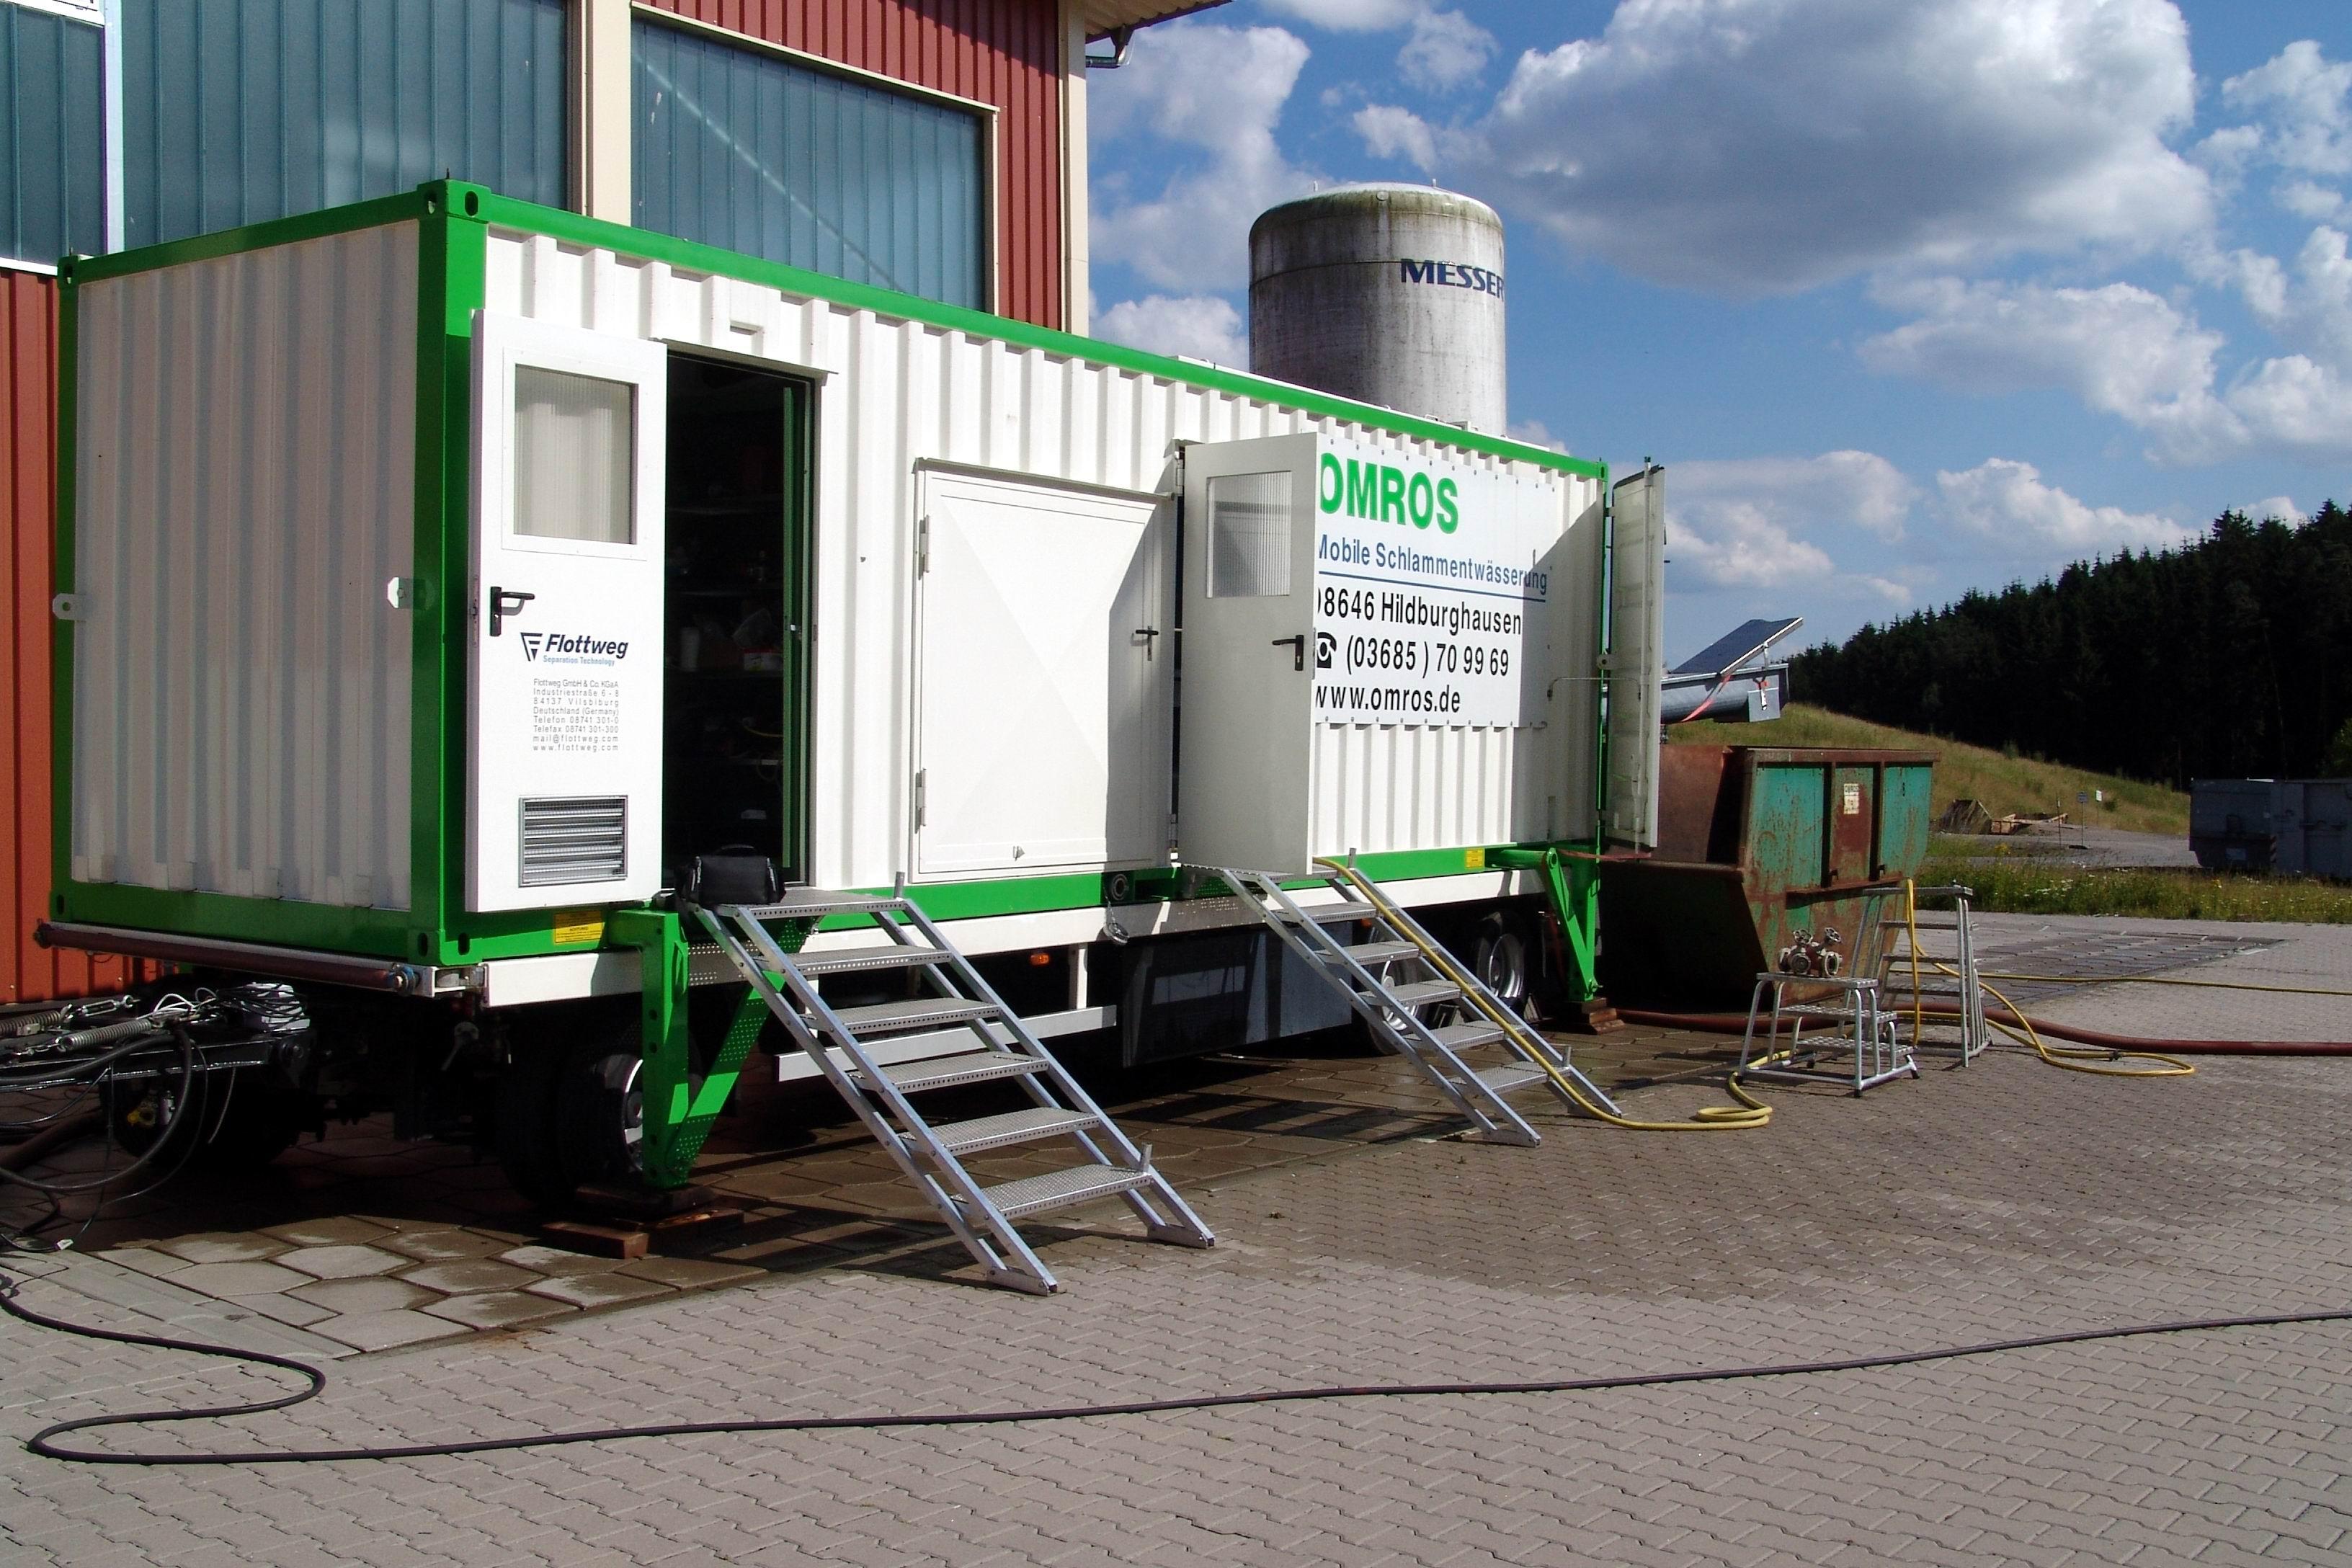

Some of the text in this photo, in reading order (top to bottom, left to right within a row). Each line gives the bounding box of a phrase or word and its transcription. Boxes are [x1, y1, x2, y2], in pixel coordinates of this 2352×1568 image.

[1401, 258, 1504, 302] MESSER
[1320, 453, 1459, 534] OMROS
[1376, 542, 1548, 595] Schlammentwässerung
[1318, 587, 1521, 636] 8646 Hildburghausen
[545, 633, 629, 659] Flottweg
[543, 655, 615, 667] Separation Technology
[1436, 643, 1457, 673] 70
[1464, 646, 1484, 674] 99
[1489, 648, 1509, 677] 69
[533, 678, 561, 688] Flottweg
[563, 679, 582, 687] GmbH
[533, 688, 597, 697] Industriestraße
[568, 698, 619, 708] Vilsbiburg
[1316, 685, 1460, 713] www.omros.de
[533, 706, 619, 716] Deutschland (Germany)
[533, 734, 618, 744] mail@flottweg.com
[533, 744, 618, 753] www.flottweg.com
